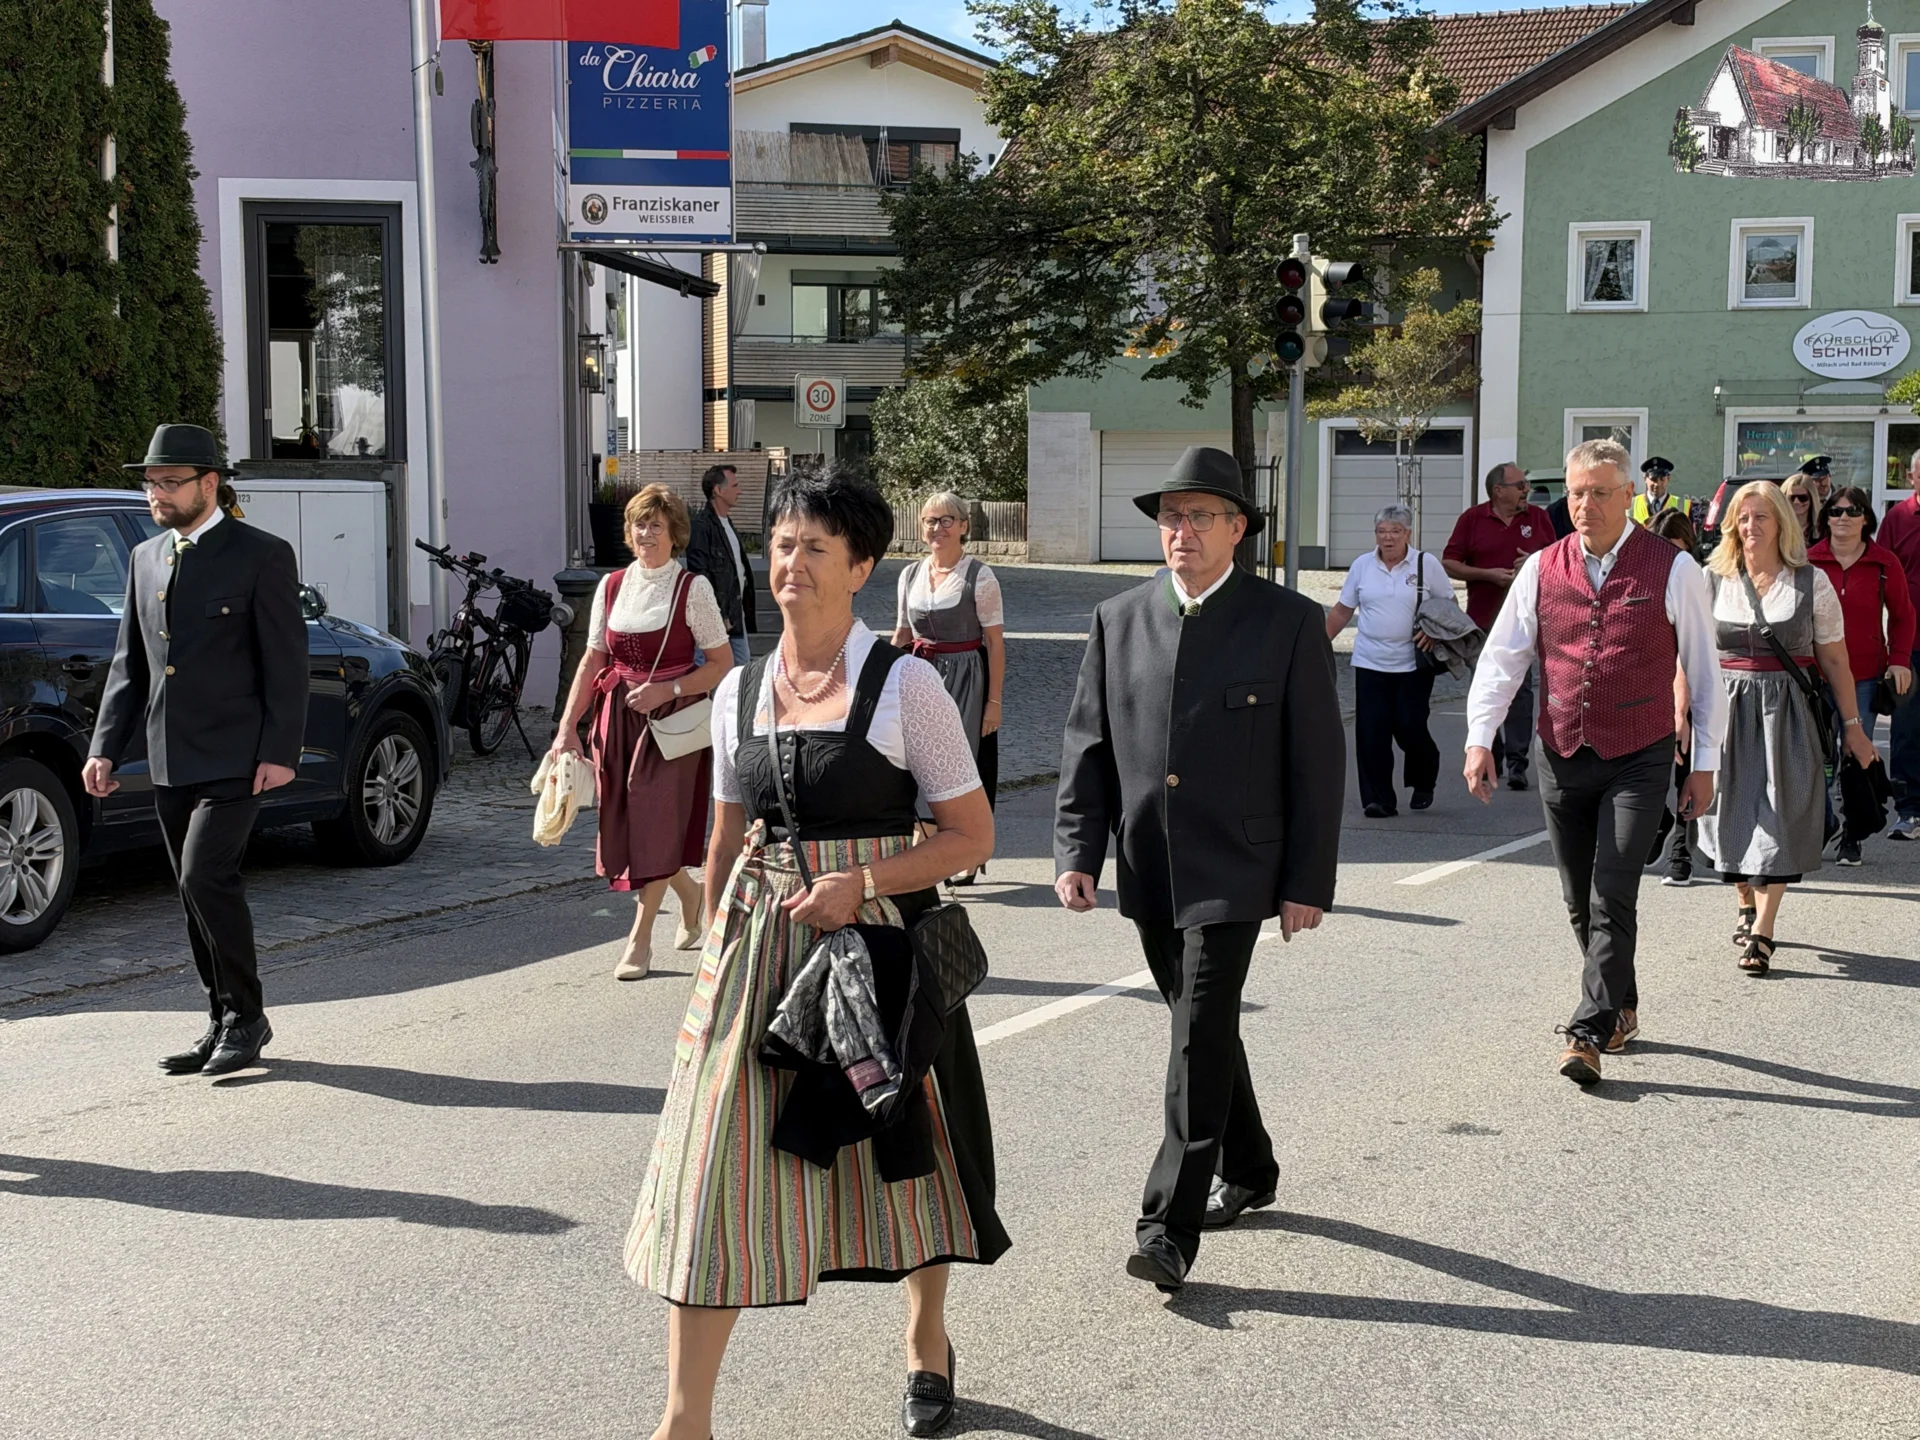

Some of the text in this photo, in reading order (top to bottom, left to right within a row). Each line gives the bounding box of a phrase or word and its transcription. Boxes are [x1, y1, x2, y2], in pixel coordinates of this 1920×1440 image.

[580, 45, 700, 91] da Chiara
[603, 97, 701, 110] PIZZERIA
[613, 196, 720, 212] Franziskaner
[639, 214, 694, 224] WEISSBIER
[1807, 334, 1900, 345] FAHRSCHULE
[1812, 346, 1893, 358] SCHMIDT
[812, 389, 830, 404] 30
[809, 413, 832, 422] ZONE
